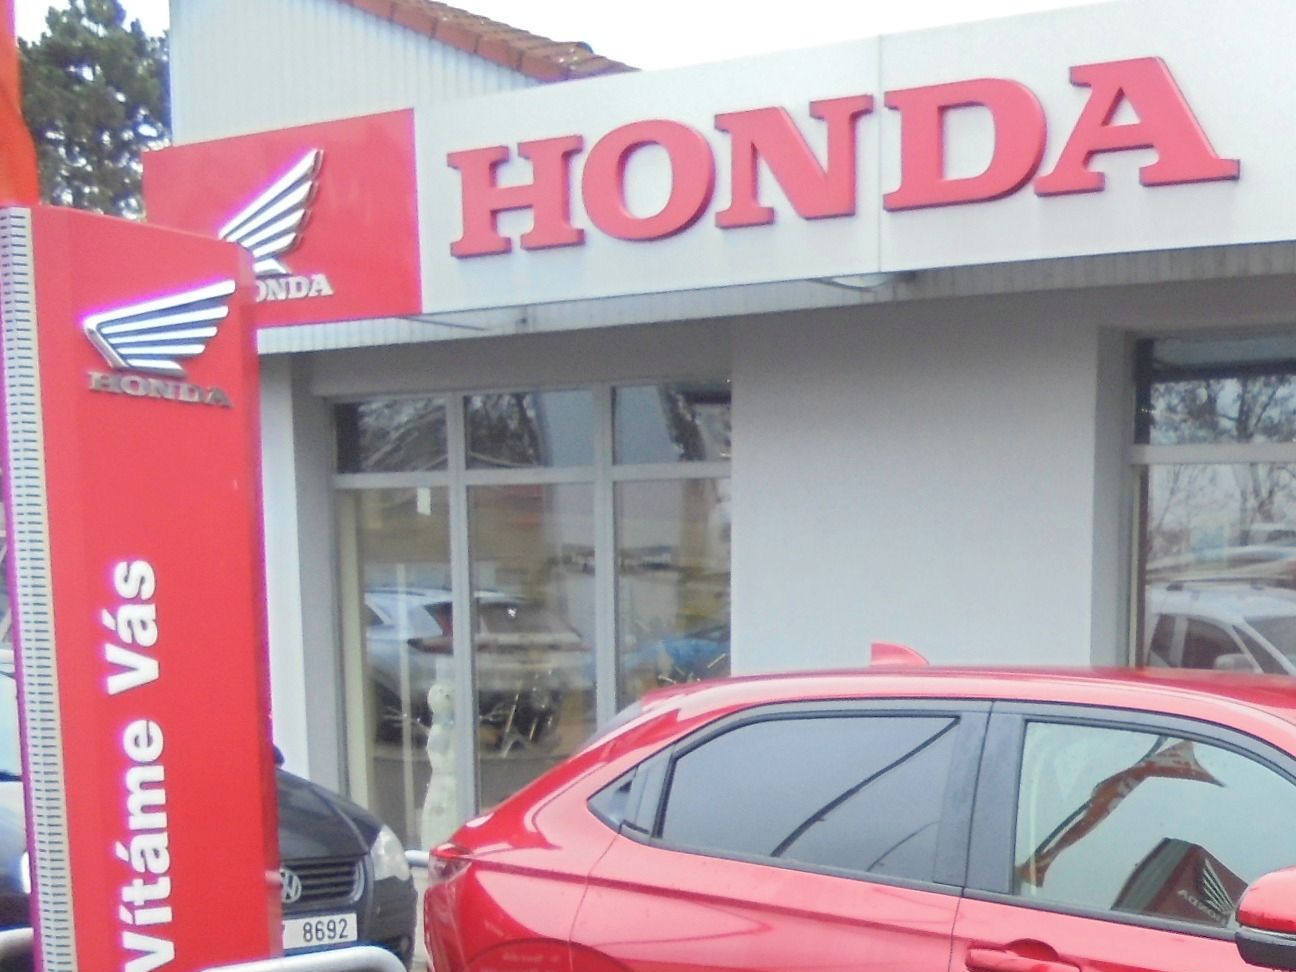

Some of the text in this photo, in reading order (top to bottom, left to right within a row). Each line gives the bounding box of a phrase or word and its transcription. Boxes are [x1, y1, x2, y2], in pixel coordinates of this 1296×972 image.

[446, 56, 1240, 259] HONDA
[255, 273, 334, 303] ONDA
[88, 371, 234, 408] HONDA
[103, 559, 159, 696] Vás
[303, 918, 348, 943] 8692
